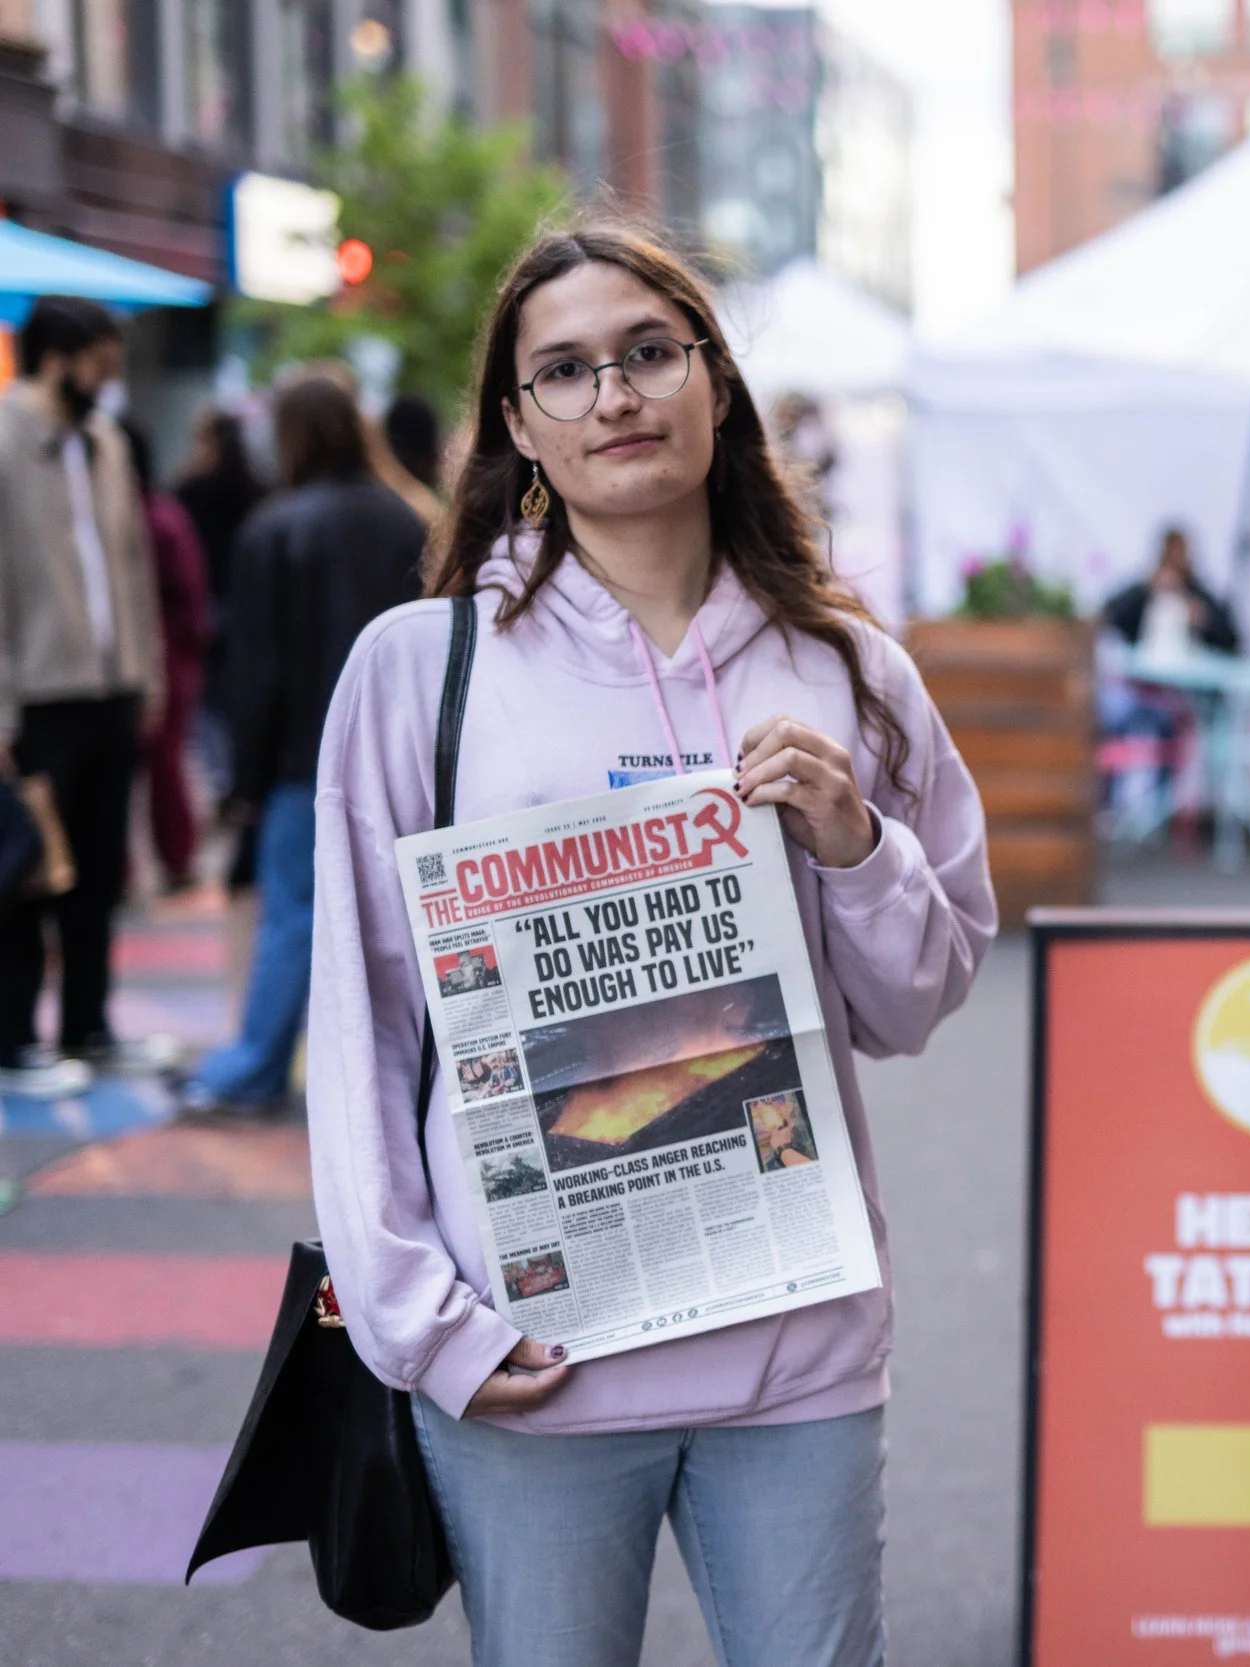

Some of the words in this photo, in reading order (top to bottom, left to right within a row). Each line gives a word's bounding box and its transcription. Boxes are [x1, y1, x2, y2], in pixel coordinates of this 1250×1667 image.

[421, 896, 463, 929] THE
[456, 811, 689, 905] COMMUNIST
[467, 905, 491, 917] VOICE
[494, 902, 505, 912] OF
[506, 898, 522, 909] THE
[524, 884, 588, 905] REVOLUTIONARY
[590, 872, 644, 890] COMMUNISTS
[658, 861, 693, 875] AMERICA
[584, 897, 639, 934] YOU
[644, 883, 701, 922] HAD
[705, 874, 742, 907] TO
[533, 947, 572, 983] DO
[578, 932, 640, 972] WAS
[645, 919, 693, 957] PAY
[701, 910, 738, 944] US
[528, 968, 637, 1019] ENOUGH
[641, 959, 678, 993] TO
[553, 1159, 649, 1192] WORKING-CLASS
[651, 1148, 689, 1170] ANGER
[690, 1134, 747, 1159] REACHING
[557, 1195, 566, 1210] A
[568, 1182, 626, 1208] BREAKING
[627, 1172, 662, 1194] POINT
[664, 1172, 677, 1184] IN
[678, 1163, 703, 1182] THE
[703, 1158, 726, 1175] U.S.
